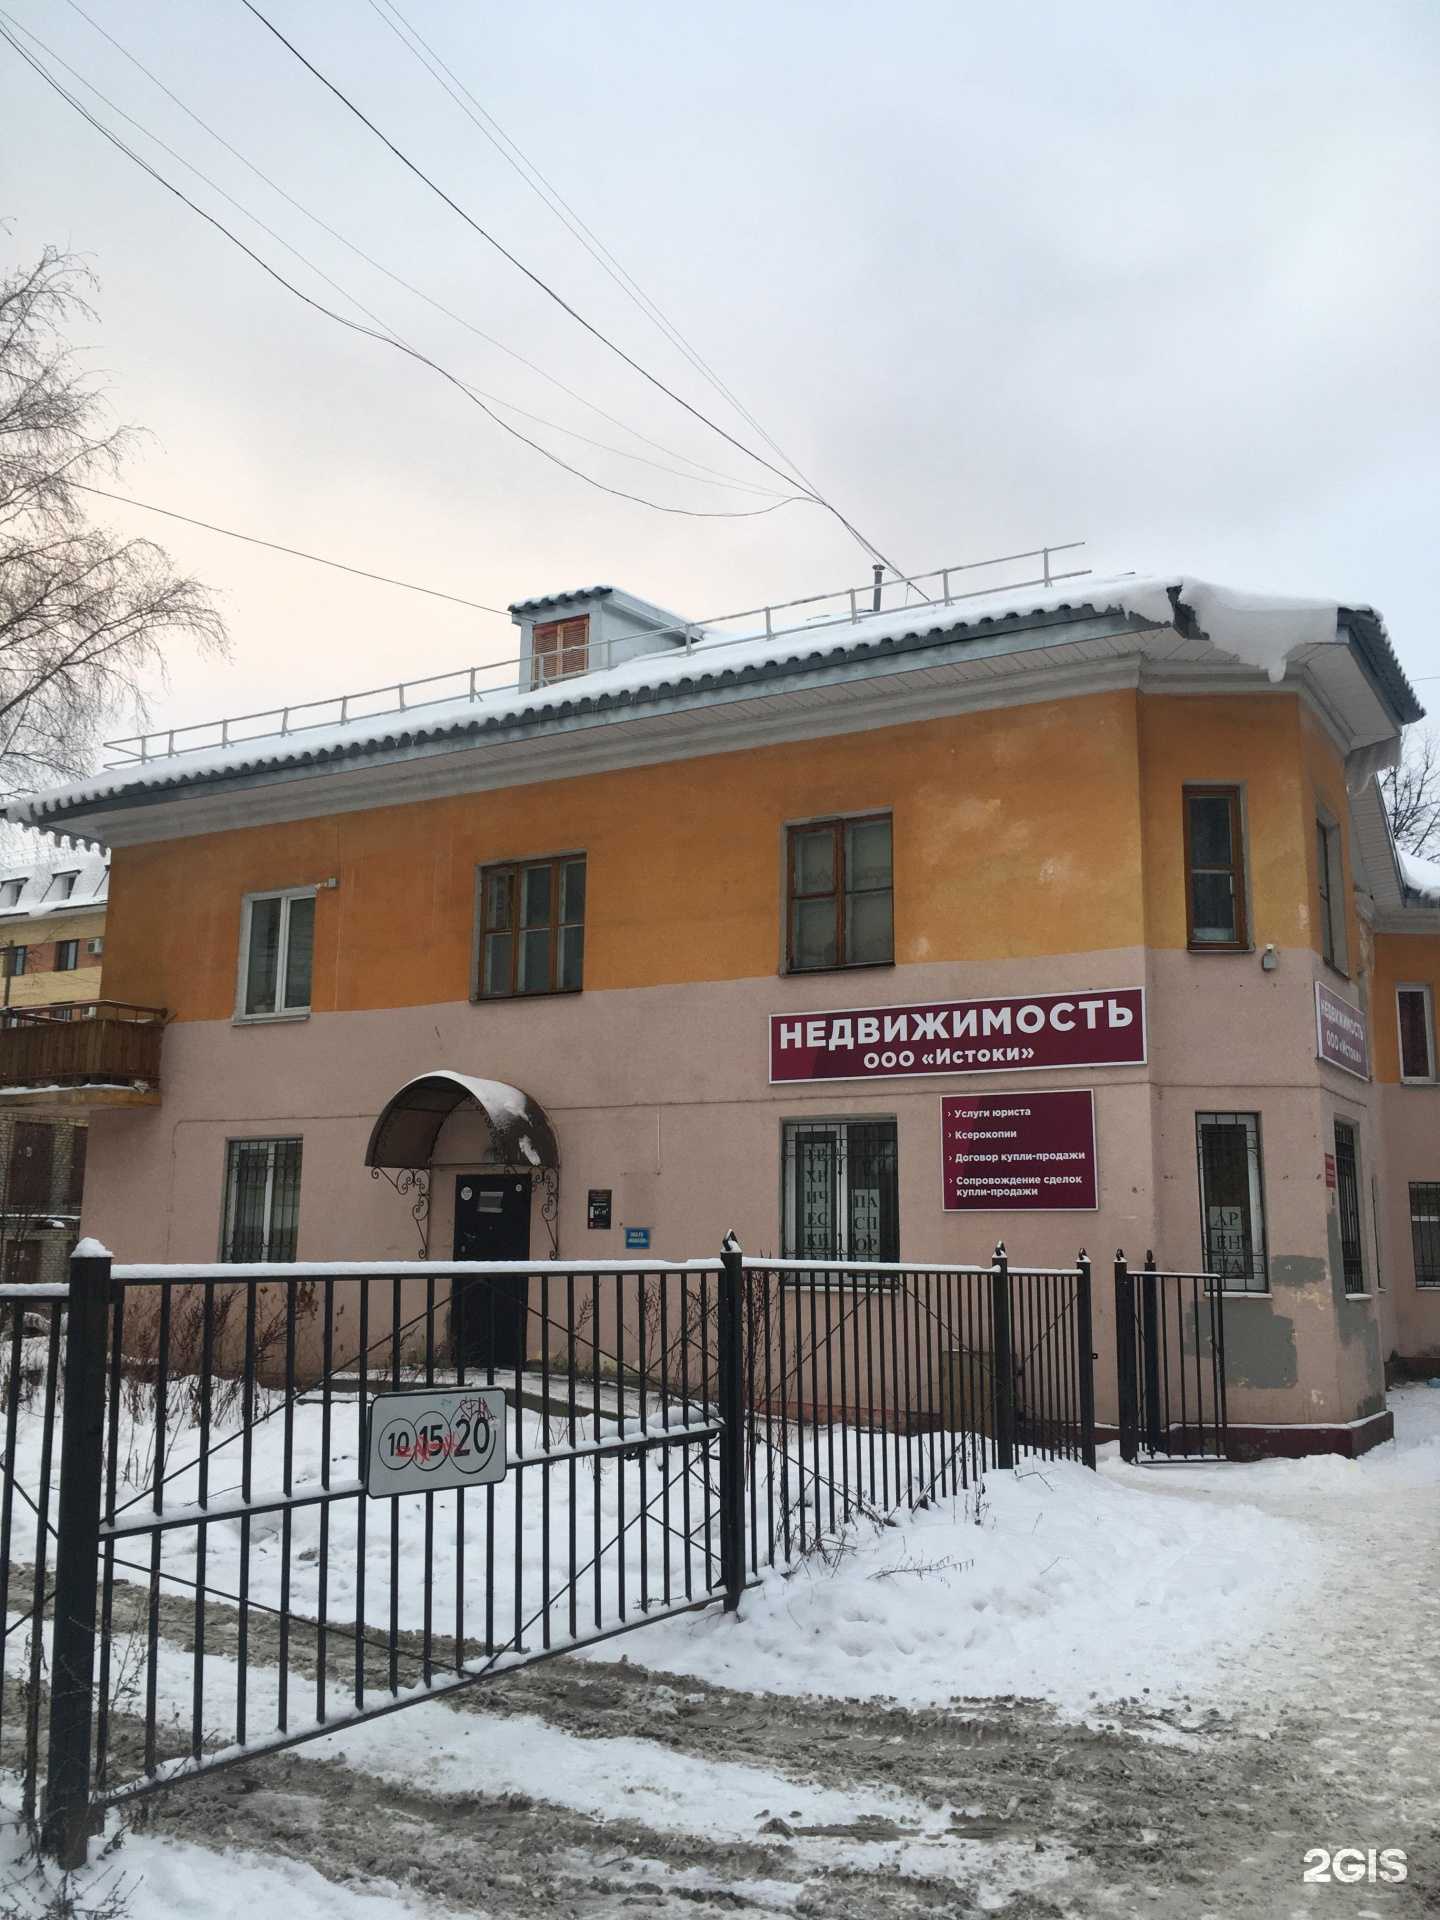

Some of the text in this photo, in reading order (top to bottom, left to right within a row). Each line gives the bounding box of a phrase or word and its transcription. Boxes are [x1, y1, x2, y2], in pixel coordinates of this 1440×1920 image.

[780, 999, 1133, 1051] НЕДВИЖИМОСТЬ
[1321, 1000, 1364, 1040] НЕДВИЖИМОСТЬ
[863, 1047, 1035, 1069] ООО «Истоки»
[954, 1108, 1031, 1118] Услуги юриста
[955, 1130, 1017, 1140] Ксерокопии
[955, 1151, 1085, 1163] Договор купли-продажи
[956, 1175, 1082, 1186] Сопровождение сделок
[956, 1187, 1038, 1197] купли-продажи
[388, 1431, 410, 1457] 10
[419, 1424, 443, 1457] 15
[454, 1418, 490, 1457] 20
